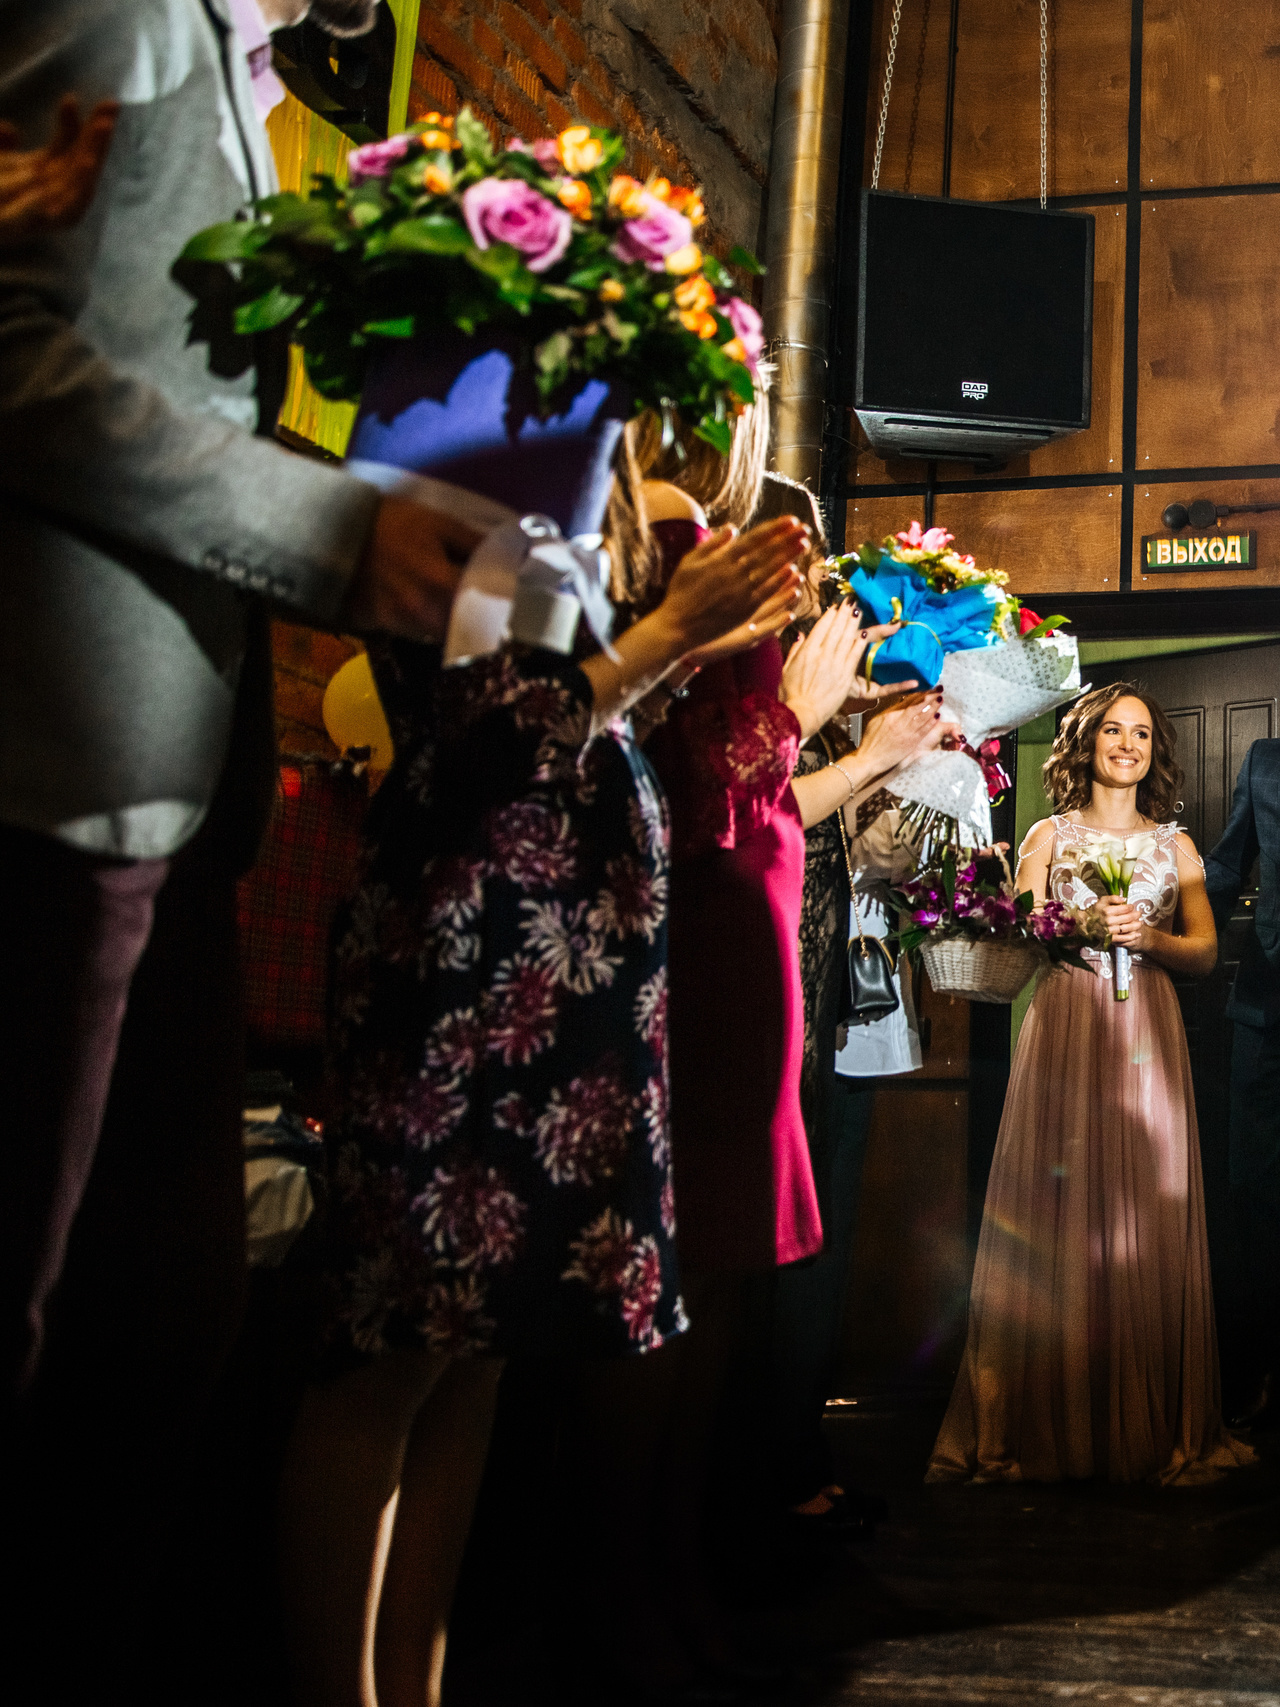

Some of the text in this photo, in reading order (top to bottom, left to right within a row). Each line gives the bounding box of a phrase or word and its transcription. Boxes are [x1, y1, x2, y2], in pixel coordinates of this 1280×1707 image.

[963, 383, 987, 391] DAP
[962, 391, 985, 400] PRO
[1156, 535, 1242, 564] ВЫХОД
